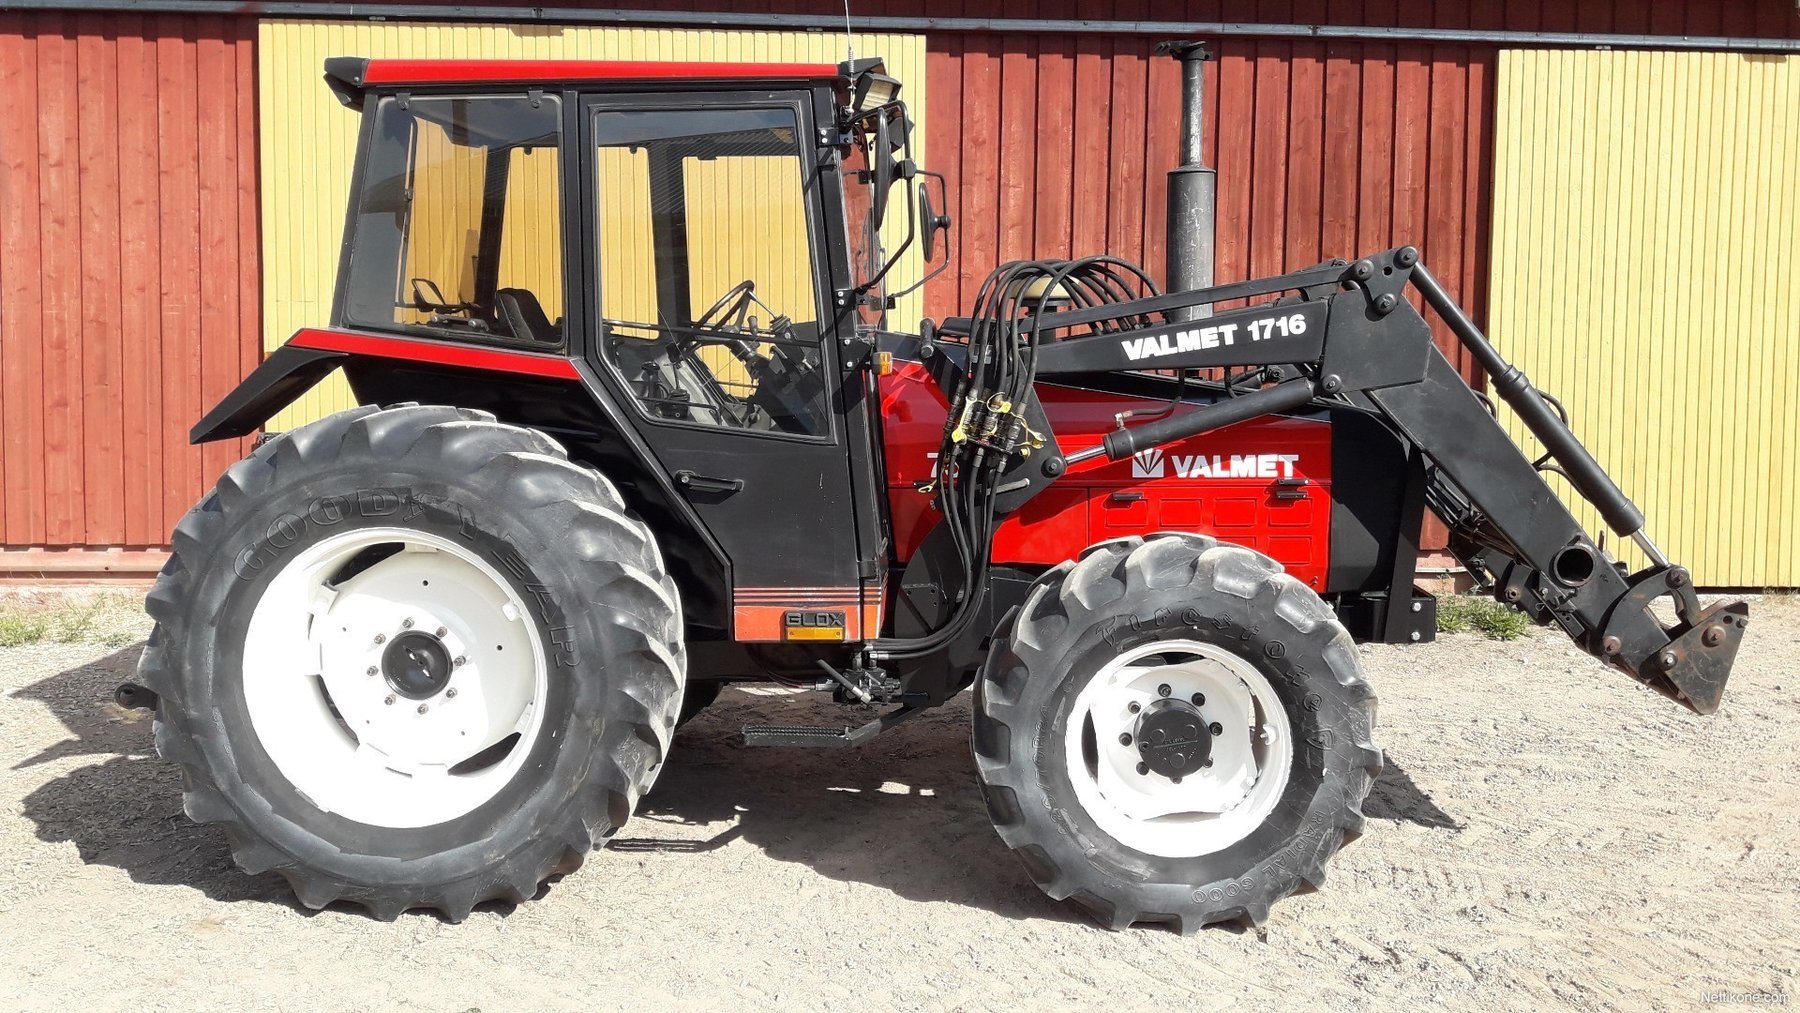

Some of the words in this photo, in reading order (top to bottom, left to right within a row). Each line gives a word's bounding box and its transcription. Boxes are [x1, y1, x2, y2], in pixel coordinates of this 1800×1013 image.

[1121, 323, 1238, 361] VALMET
[1247, 314, 1307, 342] 1716
[1172, 454, 1299, 479] VALMET
[233, 487, 582, 669] GOODYEAR
[1262, 809, 1326, 879] RADIAL
